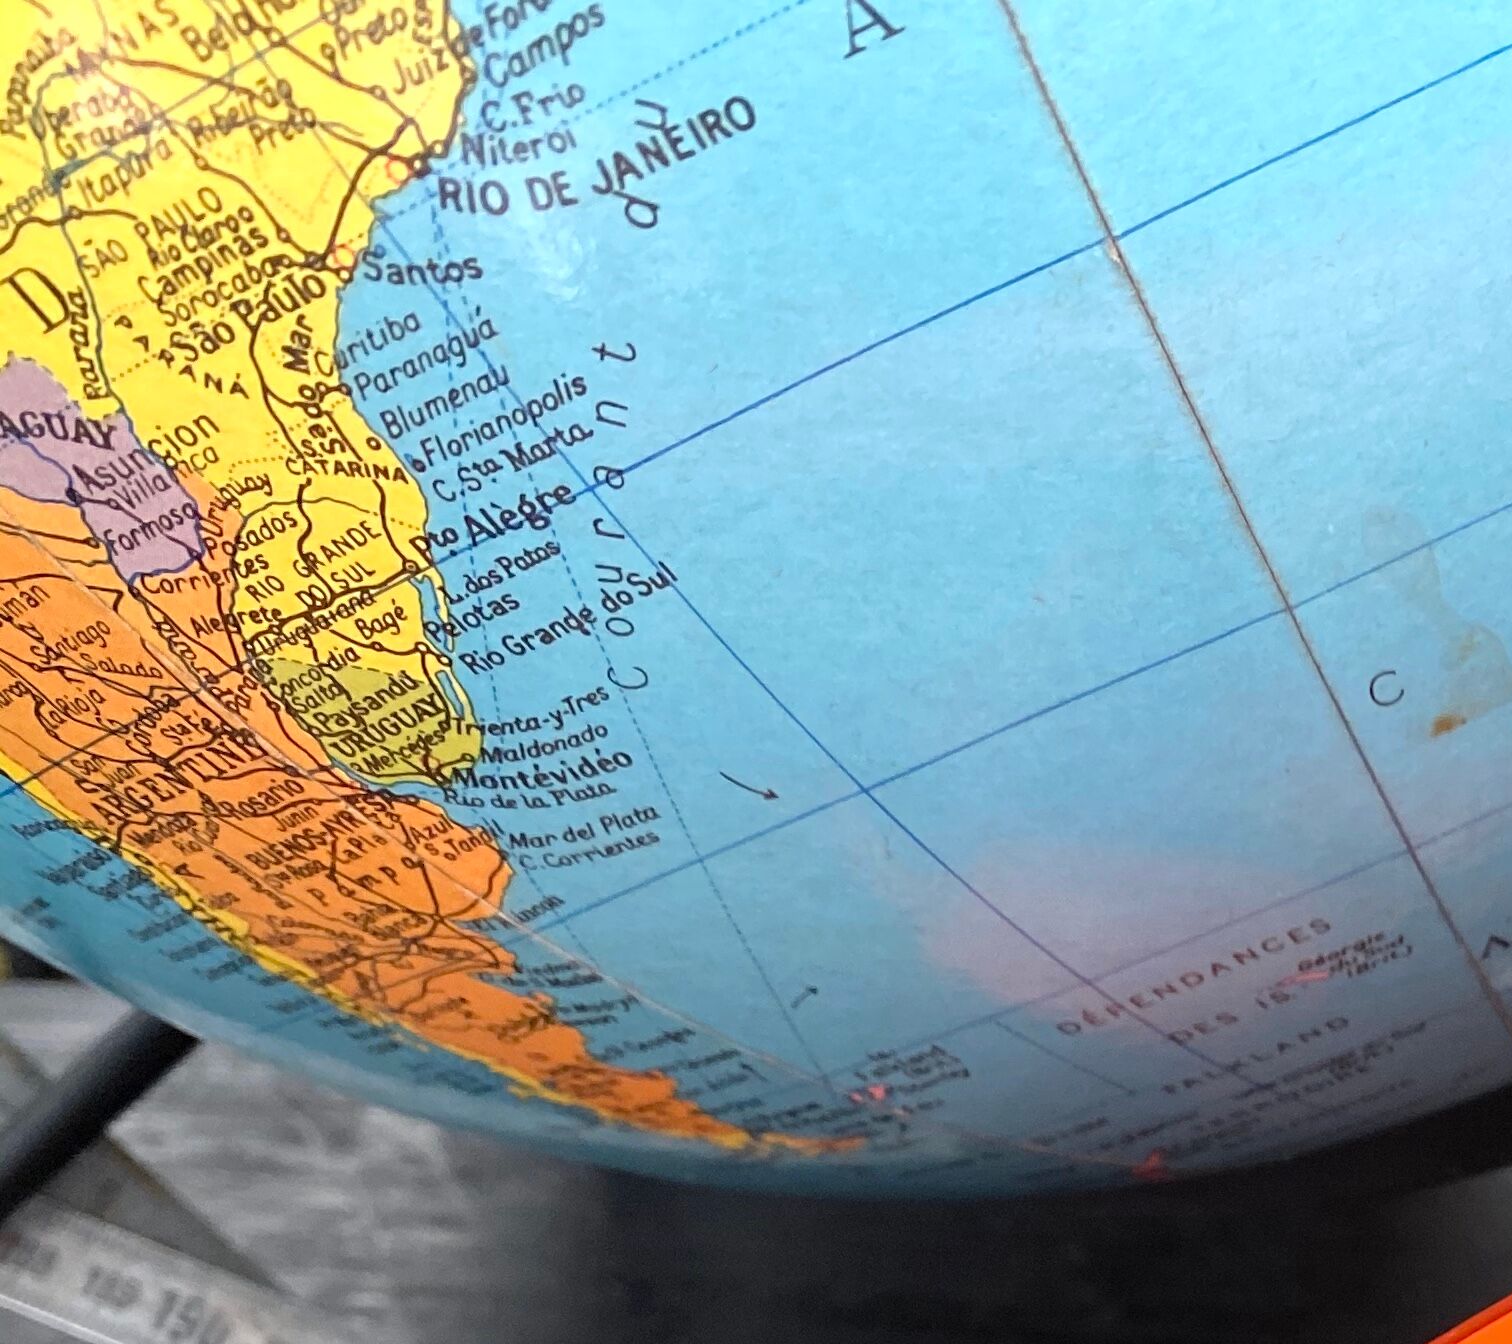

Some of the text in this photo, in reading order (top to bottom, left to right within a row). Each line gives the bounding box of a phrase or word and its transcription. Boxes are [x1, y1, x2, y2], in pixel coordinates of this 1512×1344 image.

[394, 46, 449, 95] Juiz
[484, 4, 605, 88] Campos
[438, 96, 757, 215] RIO DE JANEIRO
[134, 186, 222, 246] PAULO
[137, 227, 268, 303] Campinas
[363, 250, 484, 286] Santos
[0, 267, 69, 334] D
[170, 272, 326, 362] São Paulo
[281, 313, 314, 376] Mar
[314, 310, 421, 378] Curitiba
[354, 304, 499, 400] Paranaguá
[379, 364, 510, 440] Blumenau
[420, 373, 587, 467] Florianopolis
[286, 457, 409, 485] CATARINA
[500, 422, 594, 472] Marta
[103, 501, 198, 557] Formosa
[141, 552, 270, 595] Corrientes
[245, 519, 382, 611] RIO GRANDE DO SUL
[30, 620, 111, 666] Santiago
[354, 597, 409, 641] Bagé
[423, 592, 520, 643] Pelotas
[459, 560, 678, 676] Rio Grande do Sul
[329, 693, 446, 758] URUGUAY
[480, 723, 608, 764] Maldonado
[224, 779, 305, 822] Rosario
[491, 794, 518, 809] de
[521, 794, 552, 809] la
[550, 781, 618, 807] Plata
[409, 813, 454, 844] Azul
[509, 805, 662, 850] Mar del Plata
